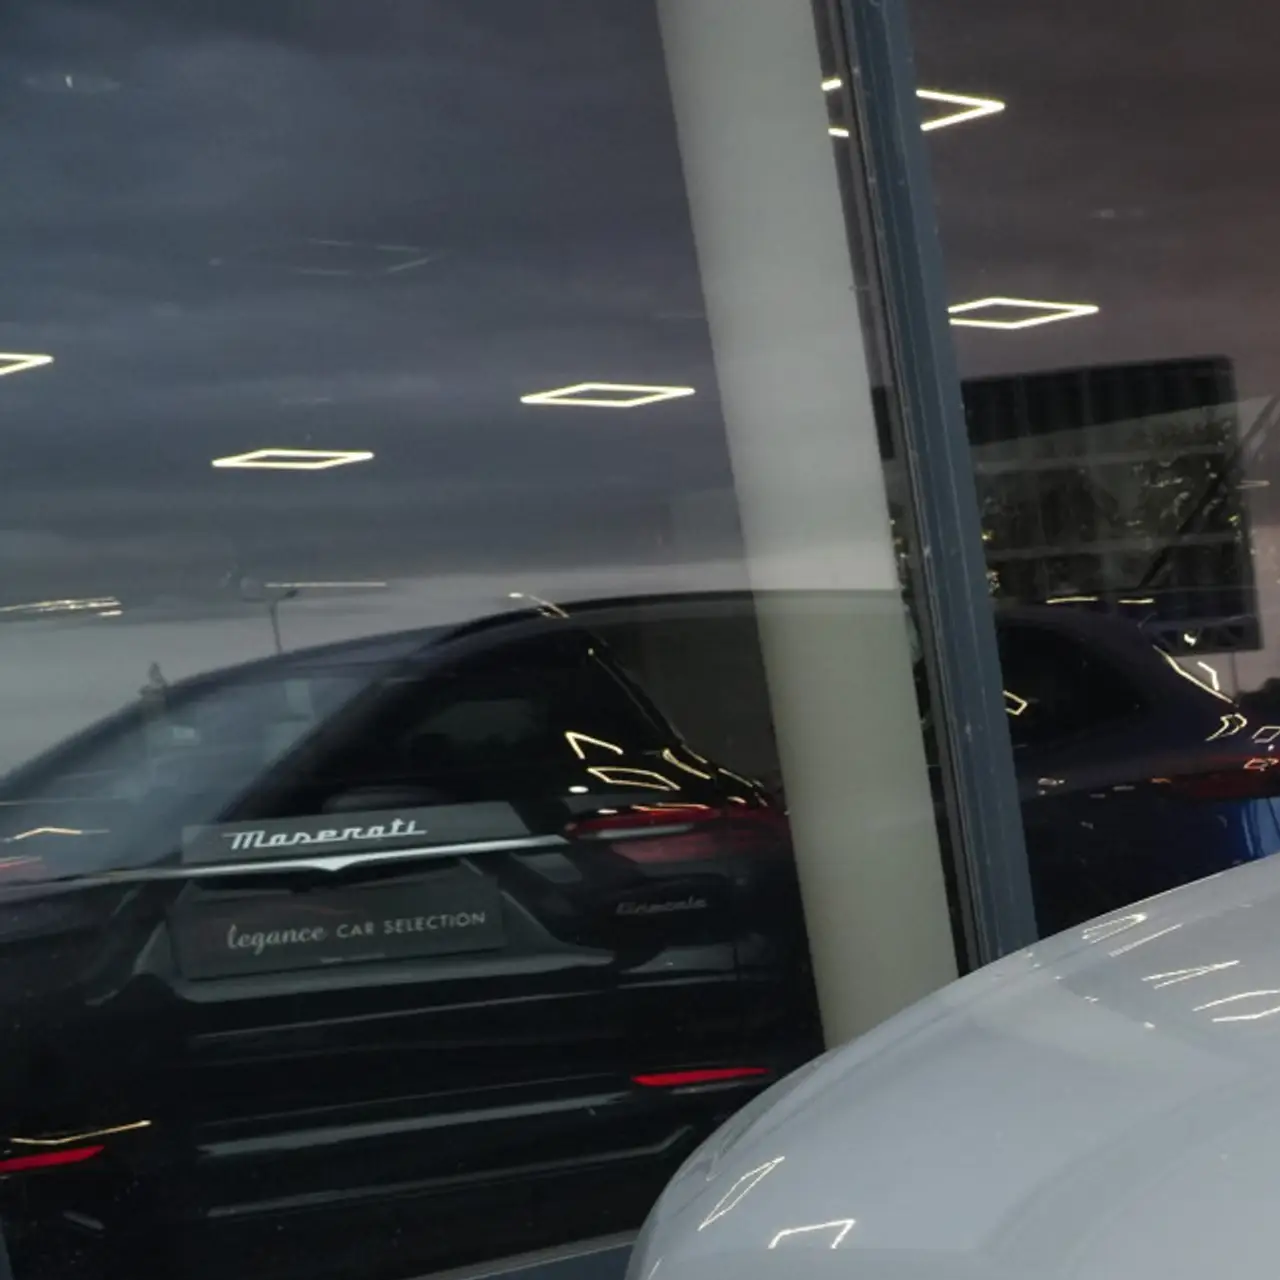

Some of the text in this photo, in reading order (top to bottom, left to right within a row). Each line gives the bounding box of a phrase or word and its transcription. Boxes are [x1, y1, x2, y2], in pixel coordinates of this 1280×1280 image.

[221, 818, 429, 849] Maserati
[335, 920, 375, 938] CAR
[384, 911, 487, 936] SELECTION
